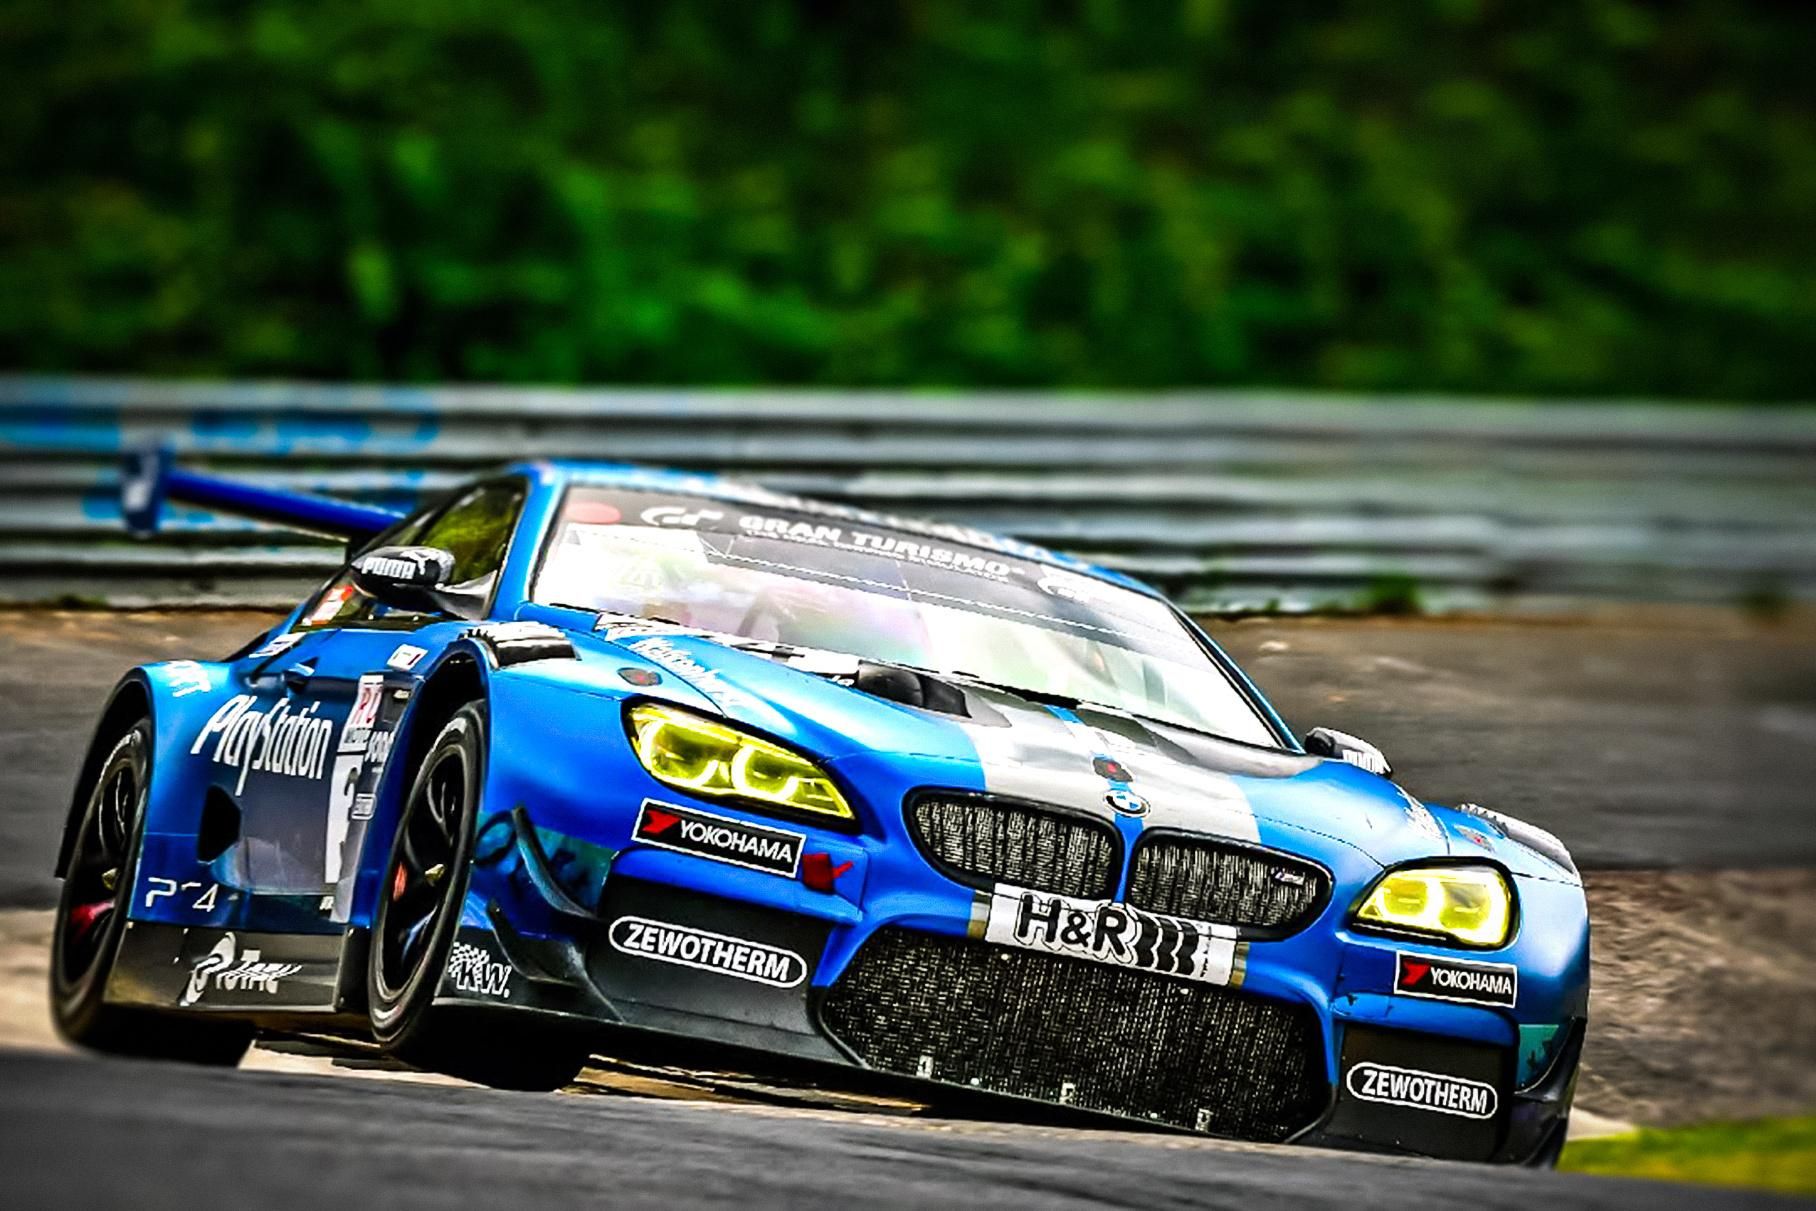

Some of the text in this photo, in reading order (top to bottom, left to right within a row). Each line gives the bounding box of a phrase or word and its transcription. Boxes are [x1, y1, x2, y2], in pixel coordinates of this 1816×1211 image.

[361, 557, 416, 580] PUMA
[739, 515, 841, 541] GRAN
[852, 532, 1010, 576] TURISMO
[190, 694, 332, 796] PlayStation
[680, 820, 793, 864] YOKOHAMA
[1016, 892, 1130, 959] H&R
[623, 923, 790, 982] ZEWOTHERM
[1430, 967, 1513, 995] YOKOHAMA
[1361, 1069, 1488, 1114] ZEWOTHERM
